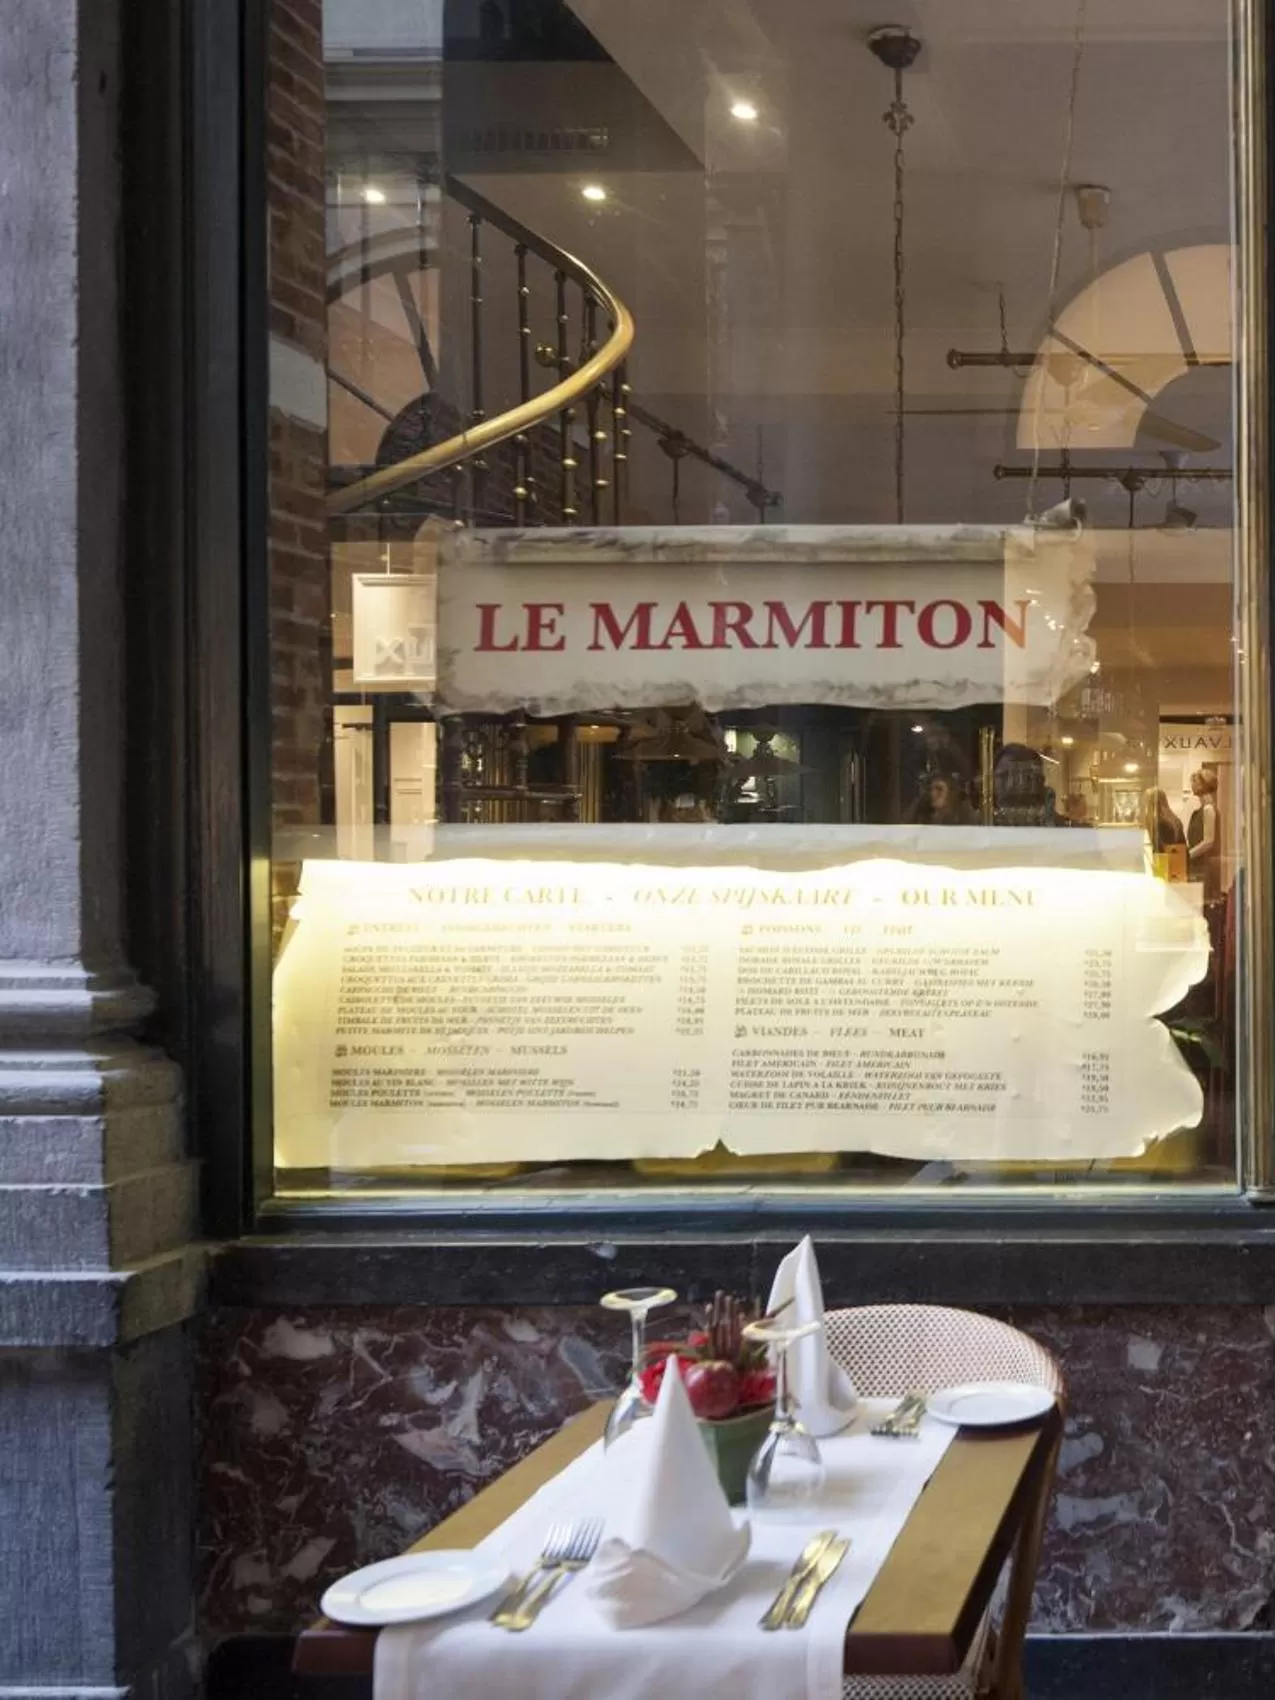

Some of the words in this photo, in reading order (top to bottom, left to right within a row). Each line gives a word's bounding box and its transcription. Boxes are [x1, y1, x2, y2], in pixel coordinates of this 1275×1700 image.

[474, 603, 564, 652] LE
[587, 600, 1031, 651] MARMITON
[409, 887, 491, 905] NOTRE
[504, 887, 584, 905] CARTE
[634, 889, 700, 906] ONZE
[901, 888, 957, 906] OUR
[967, 889, 1037, 907] MENU
[888, 1028, 925, 1038] MEAT
